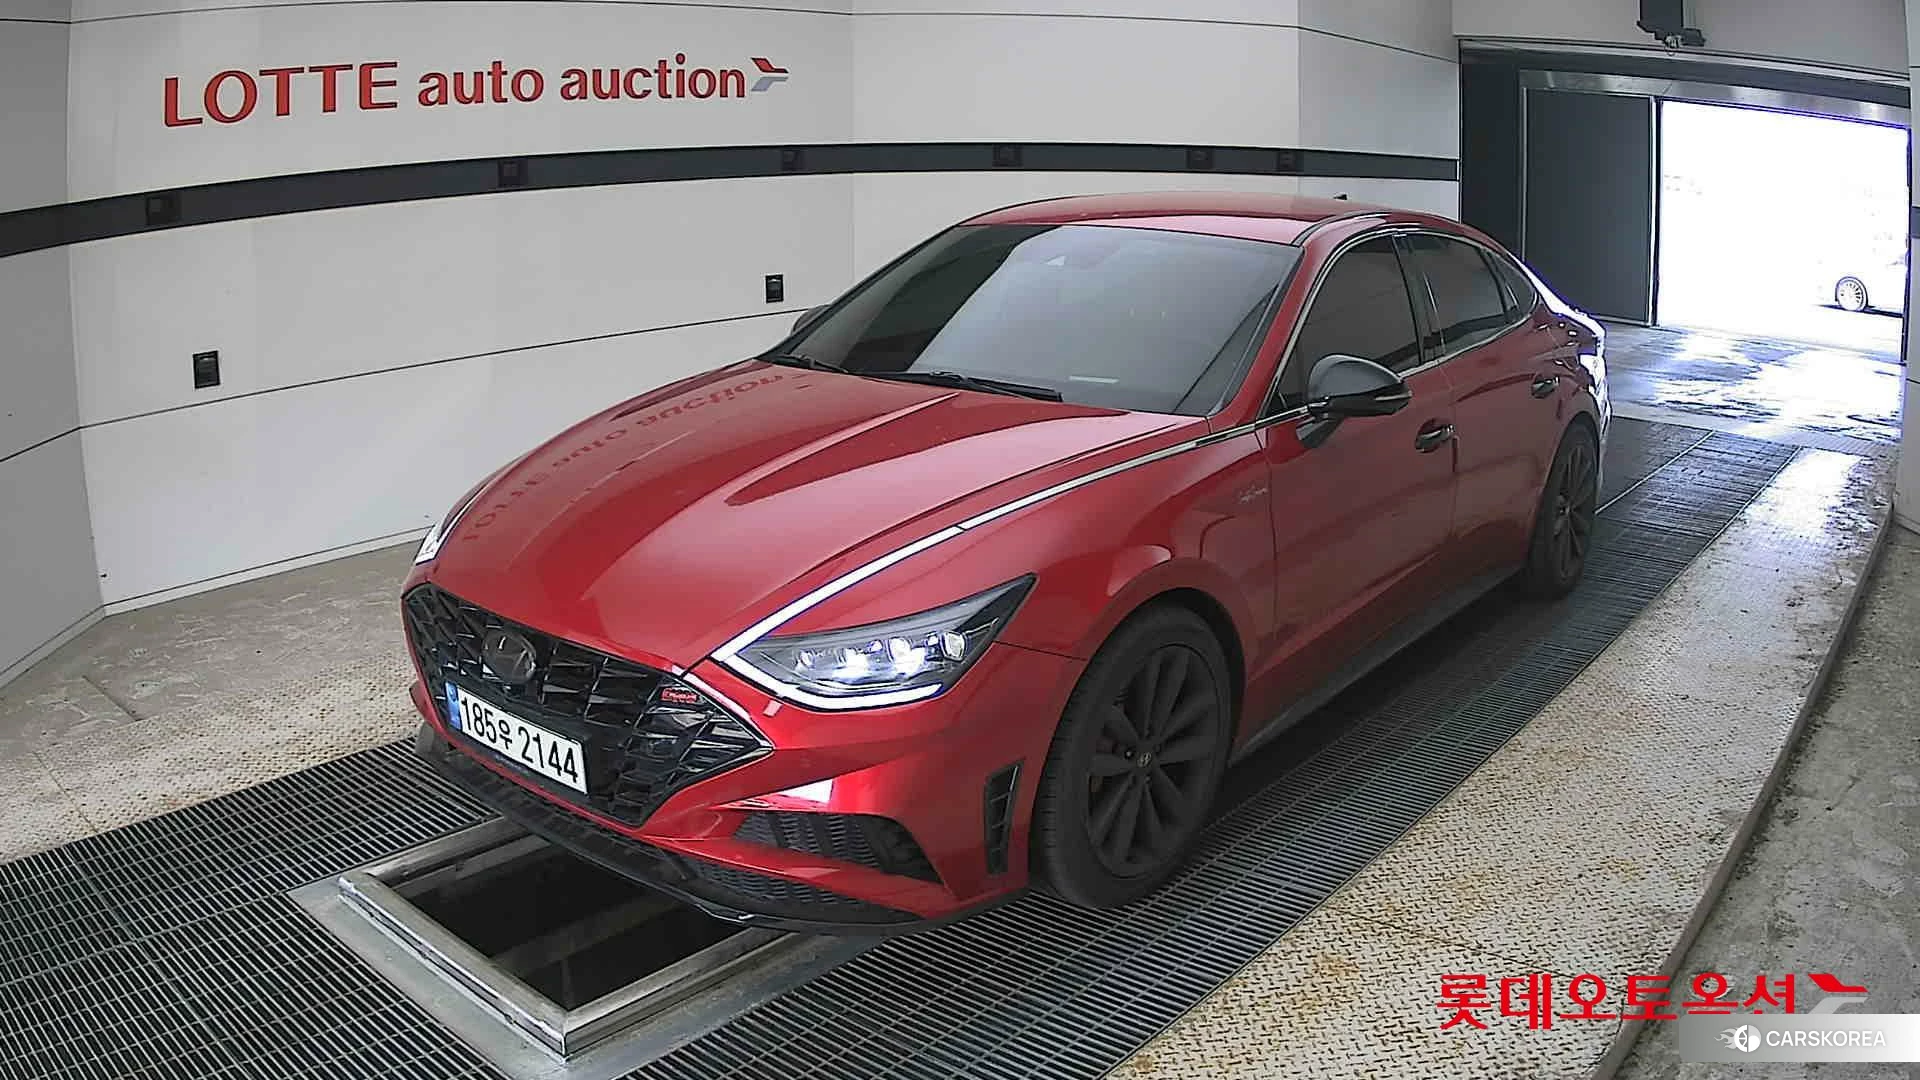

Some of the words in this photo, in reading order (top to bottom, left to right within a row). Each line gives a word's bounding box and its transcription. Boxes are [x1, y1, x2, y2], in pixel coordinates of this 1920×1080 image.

[163, 60, 399, 127] LOTTE
[417, 60, 545, 107] auto
[559, 53, 747, 100] auction
[461, 696, 513, 750] 185우
[518, 726, 578, 783] 2144
